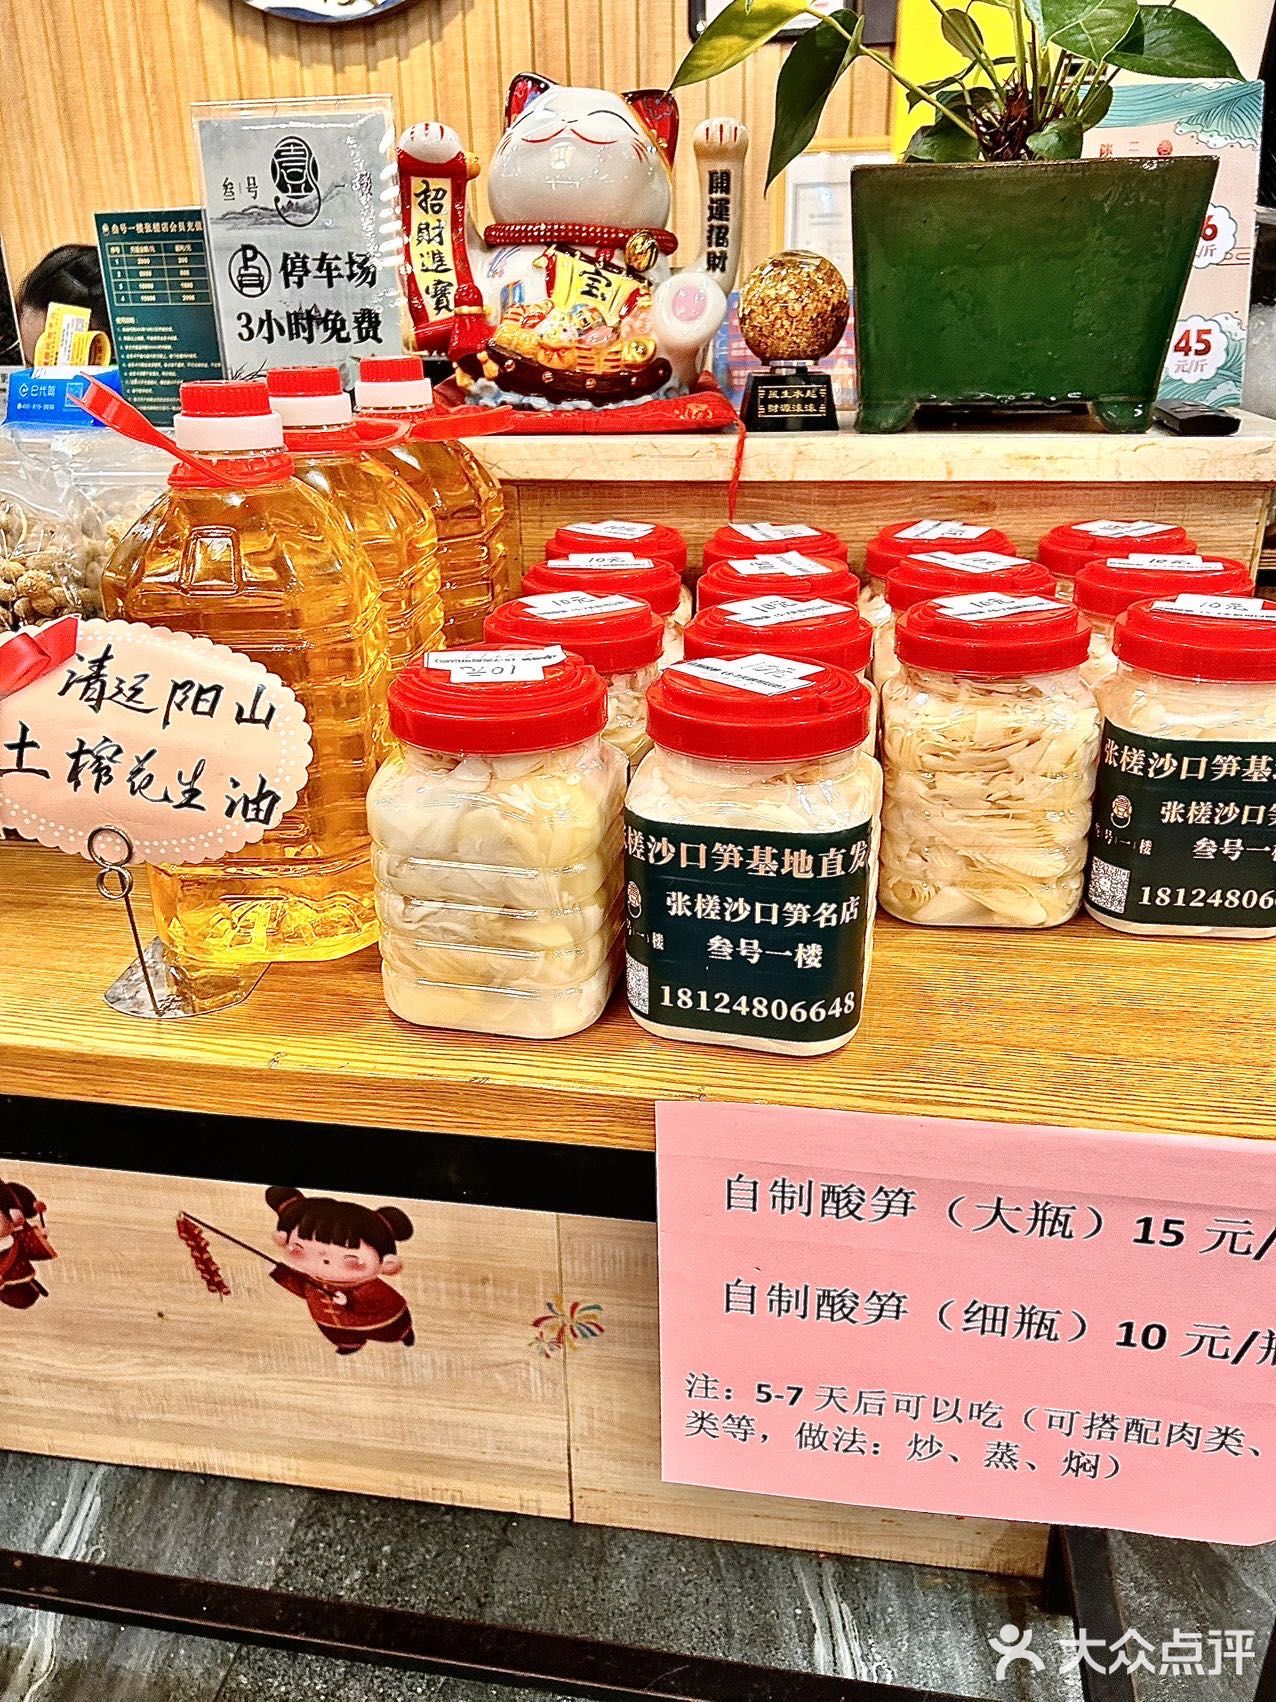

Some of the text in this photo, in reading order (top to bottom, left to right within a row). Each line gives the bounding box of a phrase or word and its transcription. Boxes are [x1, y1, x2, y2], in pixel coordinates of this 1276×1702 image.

[706, 169, 731, 273] 開運招財
[413, 179, 455, 314] 招財進寶
[279, 251, 377, 289] 停车场
[237, 308, 383, 345] 3小时免费
[1173, 328, 1212, 356] 45
[1104, 738, 1276, 782] 张槎沙口笋基
[623, 825, 868, 879] 槎沙口笋基地直发
[1192, 837, 1276, 861] 叁号一
[665, 891, 860, 928] 张槎沙口笋名店
[1138, 886, 1276, 910] 18124806
[706, 934, 823, 969] 叁号一楼
[659, 985, 855, 1023] 18124806648
[1133, 1216, 1185, 1247] 15
[1115, 1321, 1168, 1350] 10
